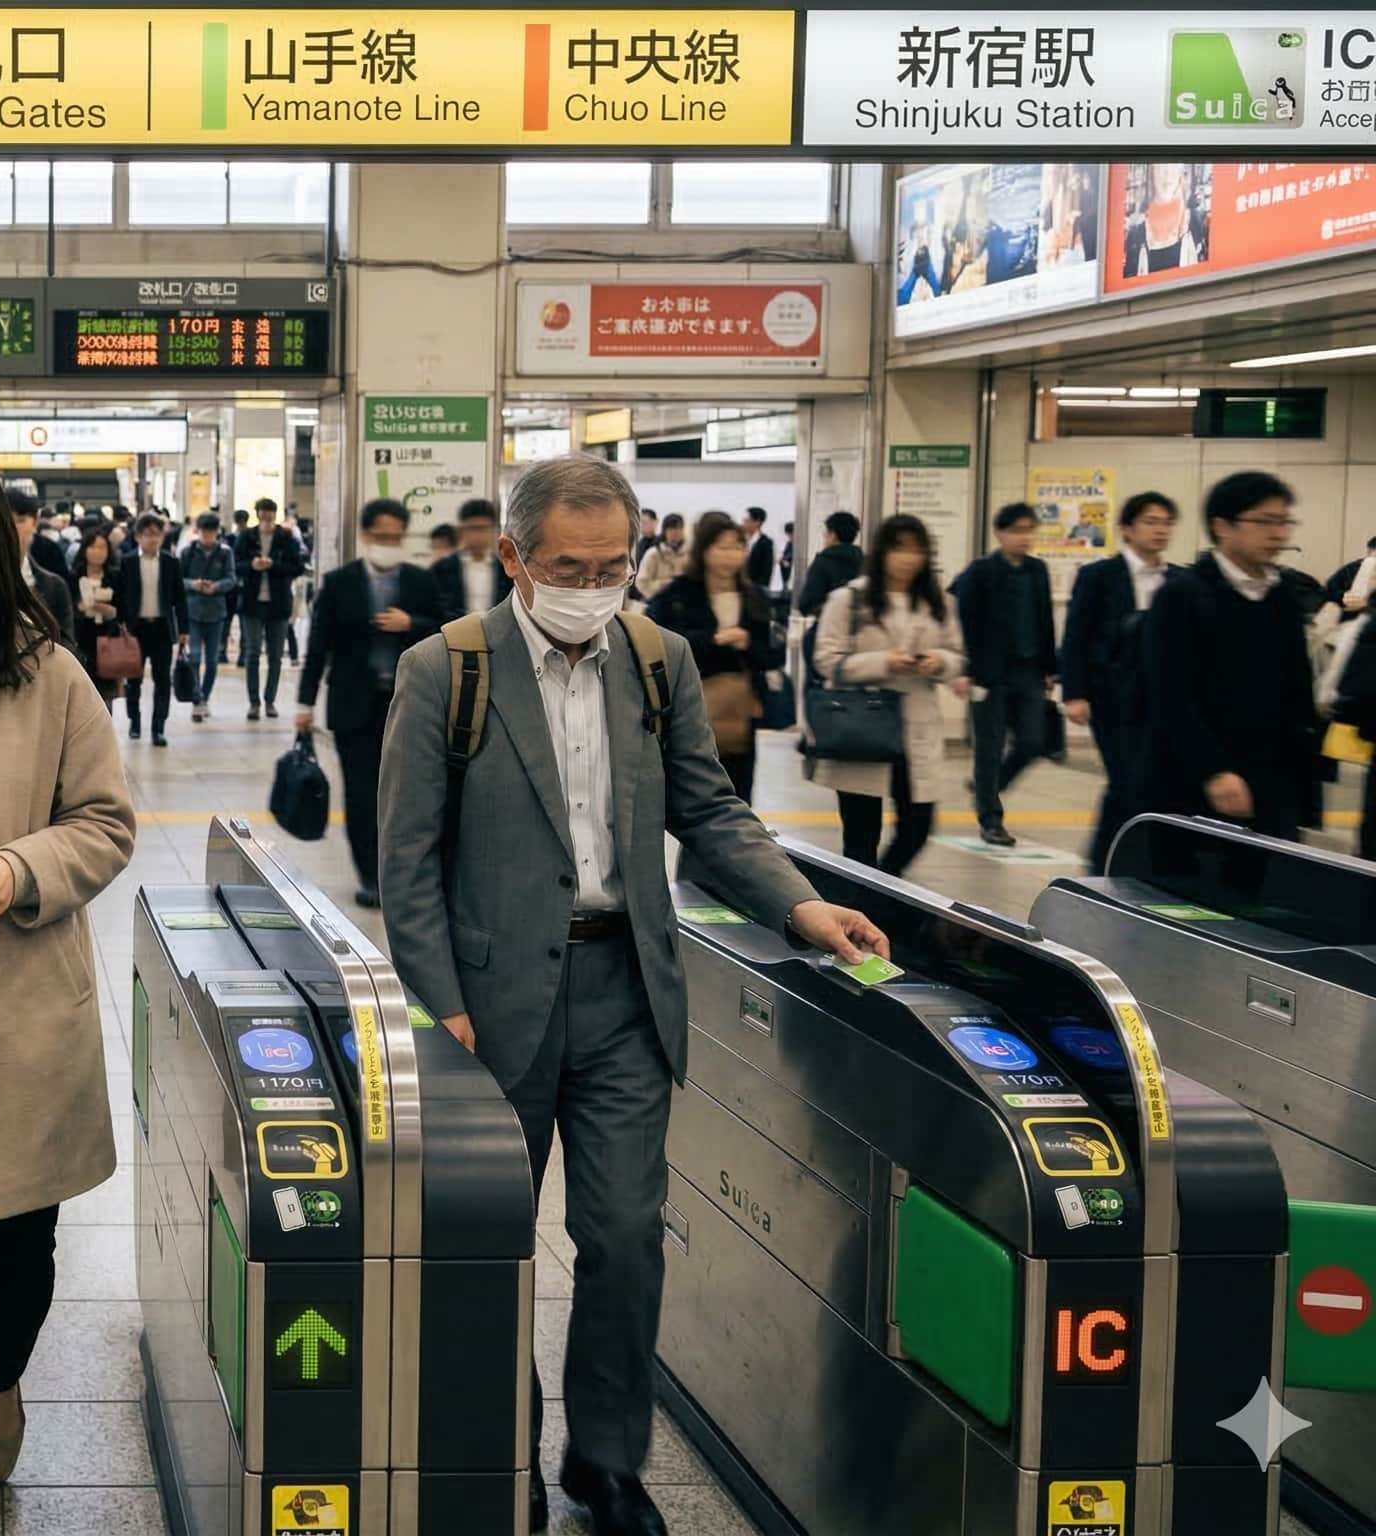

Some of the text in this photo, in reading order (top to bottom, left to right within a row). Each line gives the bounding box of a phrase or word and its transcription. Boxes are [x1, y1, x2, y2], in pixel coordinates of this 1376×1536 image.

[244, 28, 418, 85] 山手線
[567, 28, 741, 86] 中央線
[897, 26, 1095, 89] 新宿駅
[1323, 28, 1376, 70] IC
[242, 92, 481, 122] Yamanote Line
[565, 92, 727, 122] Chuo Line
[855, 98, 1135, 136] Shinjuku Station
[1175, 92, 1294, 120] Suica
[1320, 108, 1376, 132] Acce
[168, 318, 220, 334] 170円
[720, 1170, 771, 1234] Suica
[1056, 1309, 1127, 1372] IC
